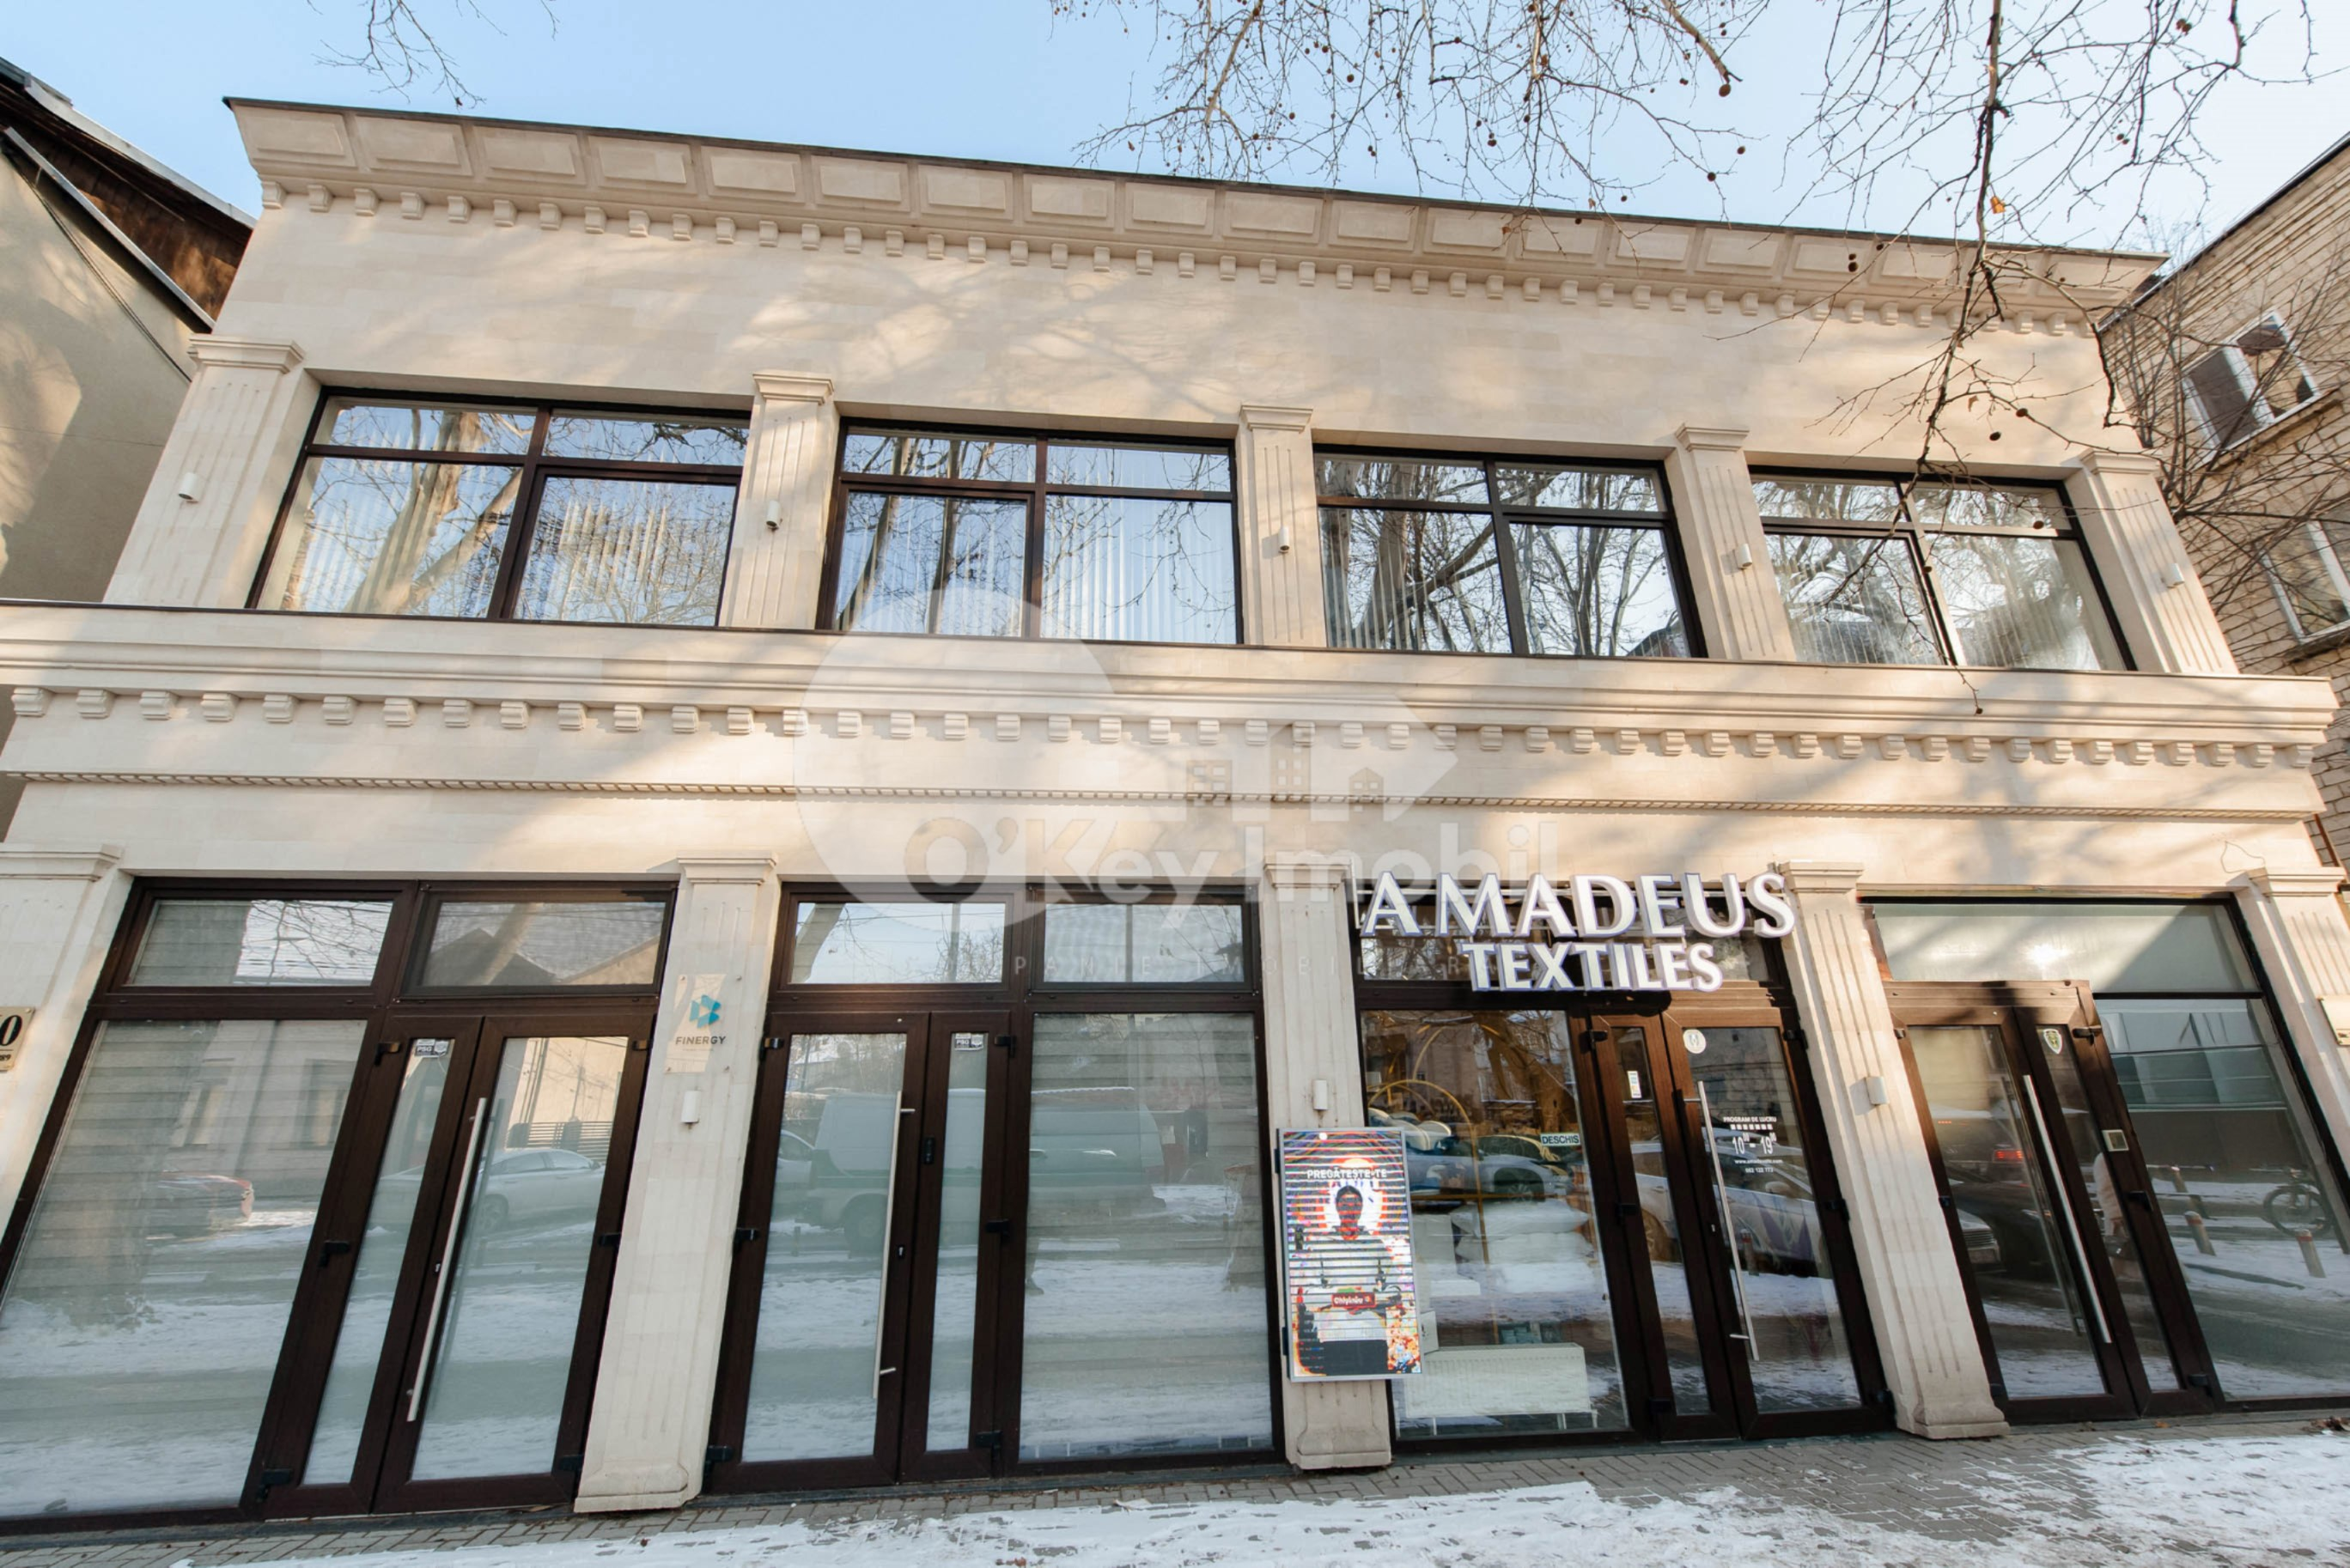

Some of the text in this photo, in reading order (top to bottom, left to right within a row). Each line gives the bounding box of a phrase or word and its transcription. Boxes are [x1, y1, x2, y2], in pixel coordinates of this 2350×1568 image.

[1361, 871, 1797, 939] AMADEUS
[1460, 943, 1723, 993] TEXTILES
[675, 1036, 727, 1045] FINERGY
[1542, 1134, 1580, 1145] DESCHIS
